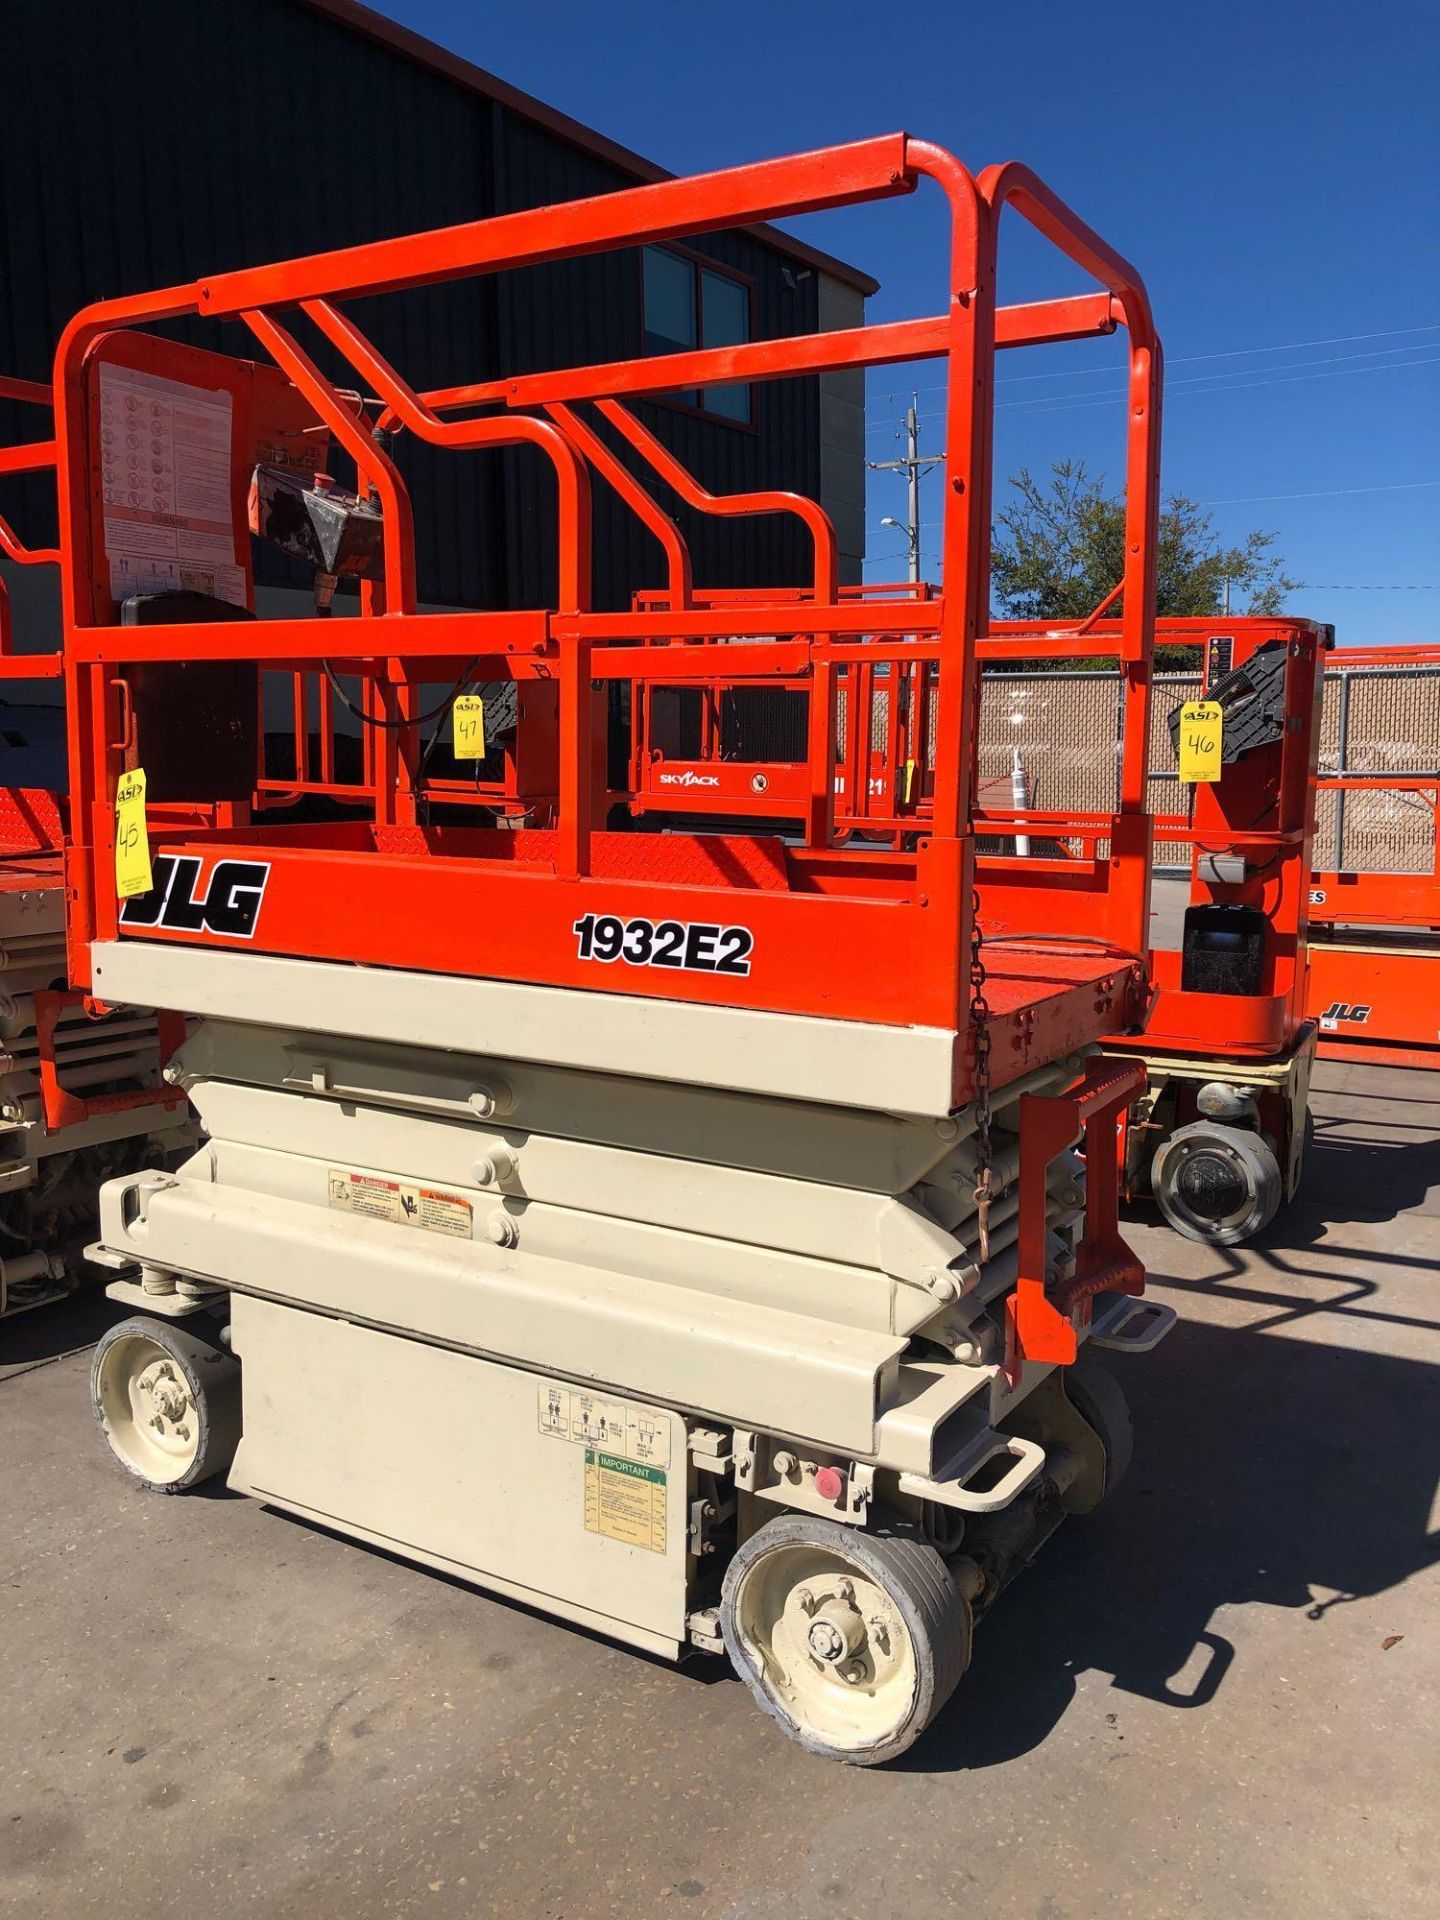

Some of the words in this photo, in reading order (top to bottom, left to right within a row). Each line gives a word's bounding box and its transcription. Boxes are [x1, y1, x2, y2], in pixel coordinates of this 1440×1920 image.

[459, 720, 477, 740] 47
[1189, 734, 1215, 755] 46
[659, 770, 720, 787] SKYJACK
[118, 822, 139, 857] 45
[120, 856, 271, 937] JLG
[574, 914, 753, 976] 1932E2
[1321, 1003, 1371, 1022] JLG
[600, 1455, 650, 1478] IMPORTANT
